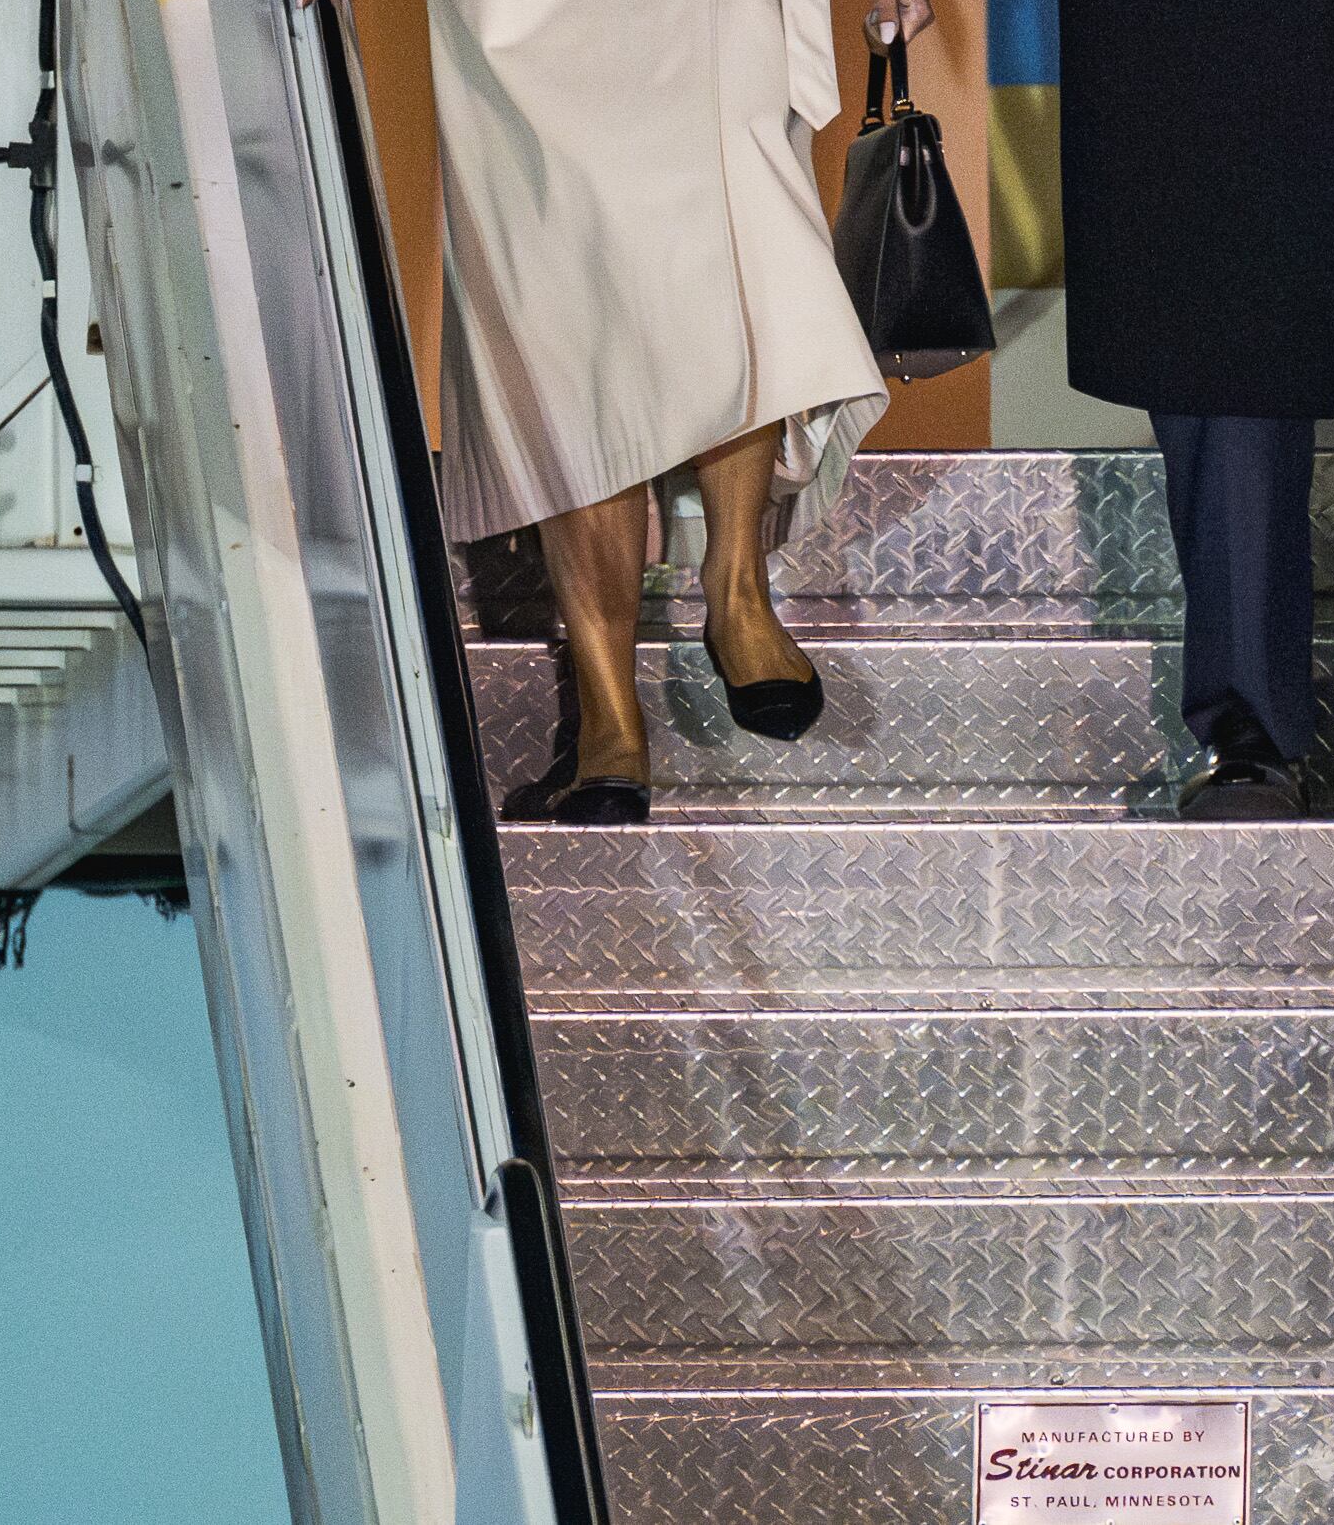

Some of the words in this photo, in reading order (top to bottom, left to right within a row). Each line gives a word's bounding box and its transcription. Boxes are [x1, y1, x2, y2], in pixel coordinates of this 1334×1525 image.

[1022, 1431, 1174, 1442] MANUFACTURED
[1183, 1431, 1205, 1442] BY
[985, 1448, 1098, 1481] Stinar
[1104, 1465, 1241, 1479] CORPORATION
[1010, 1496, 1038, 1507] ST.
[1046, 1496, 1097, 1508] PAUL,
[1105, 1495, 1214, 1506] MINNESOTA
